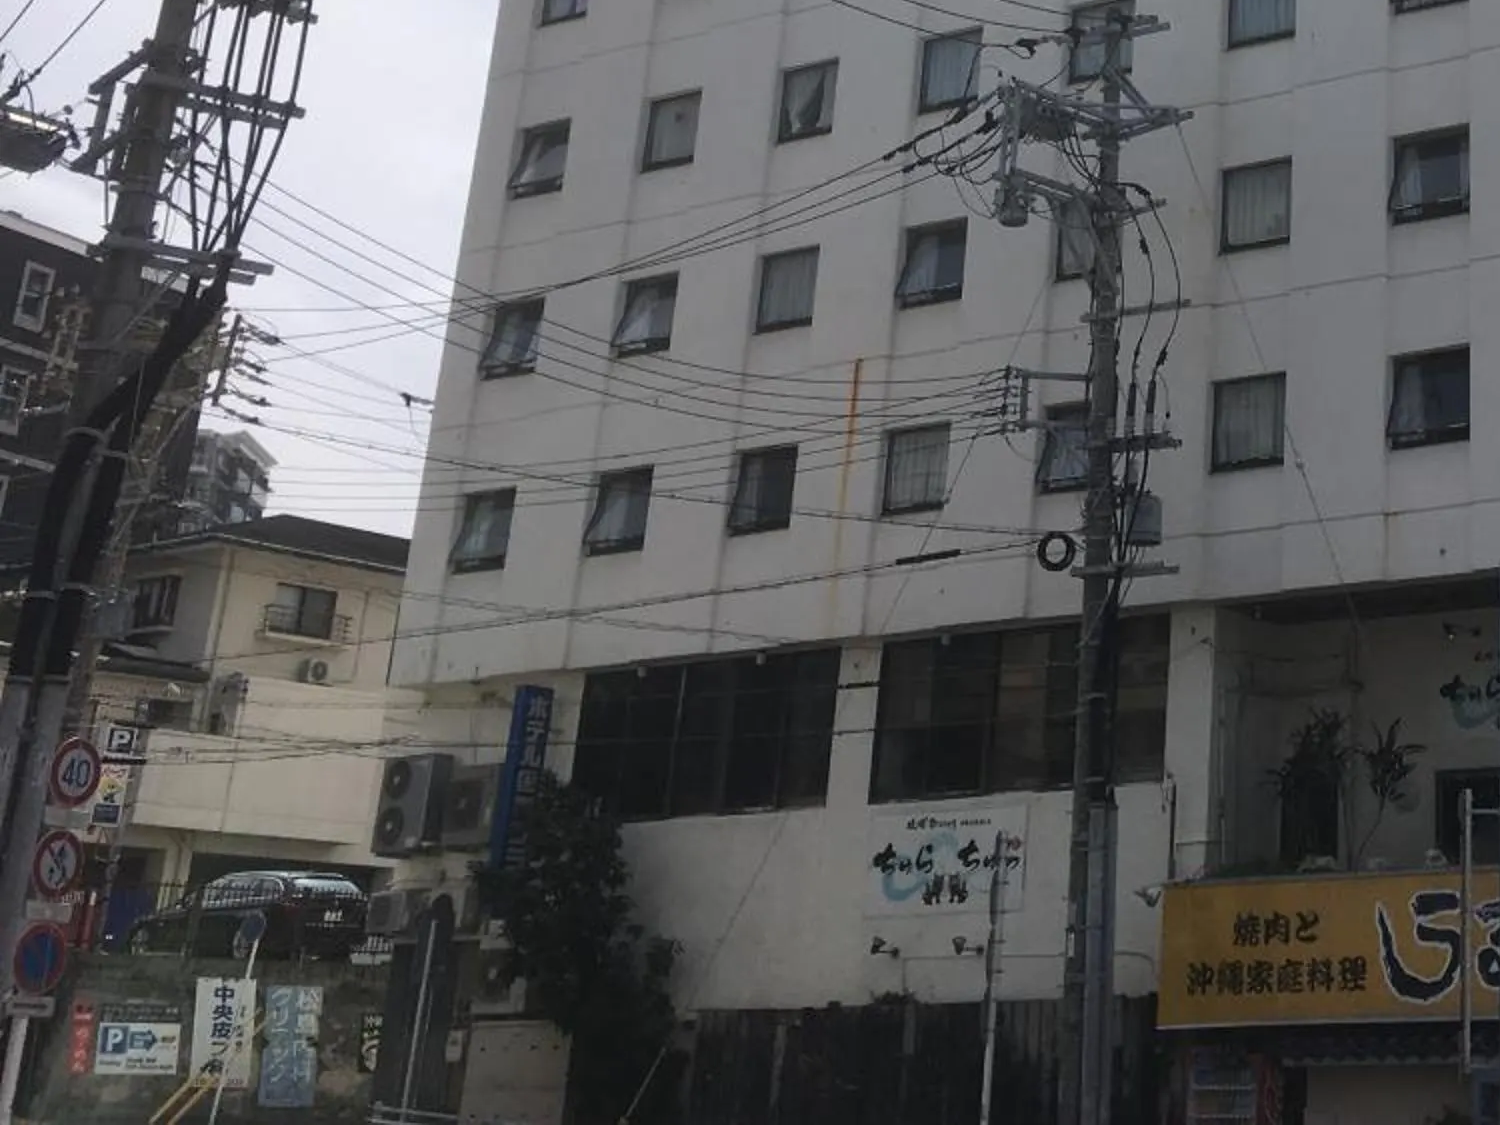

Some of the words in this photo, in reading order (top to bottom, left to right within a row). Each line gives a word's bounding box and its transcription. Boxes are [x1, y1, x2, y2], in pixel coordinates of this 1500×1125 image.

[112, 730, 131, 749] P
[62, 758, 91, 788] 40
[1232, 911, 1321, 947] 焼肉と
[1186, 956, 1367, 996] 沖縄家庭料理
[105, 1027, 124, 1052] P
